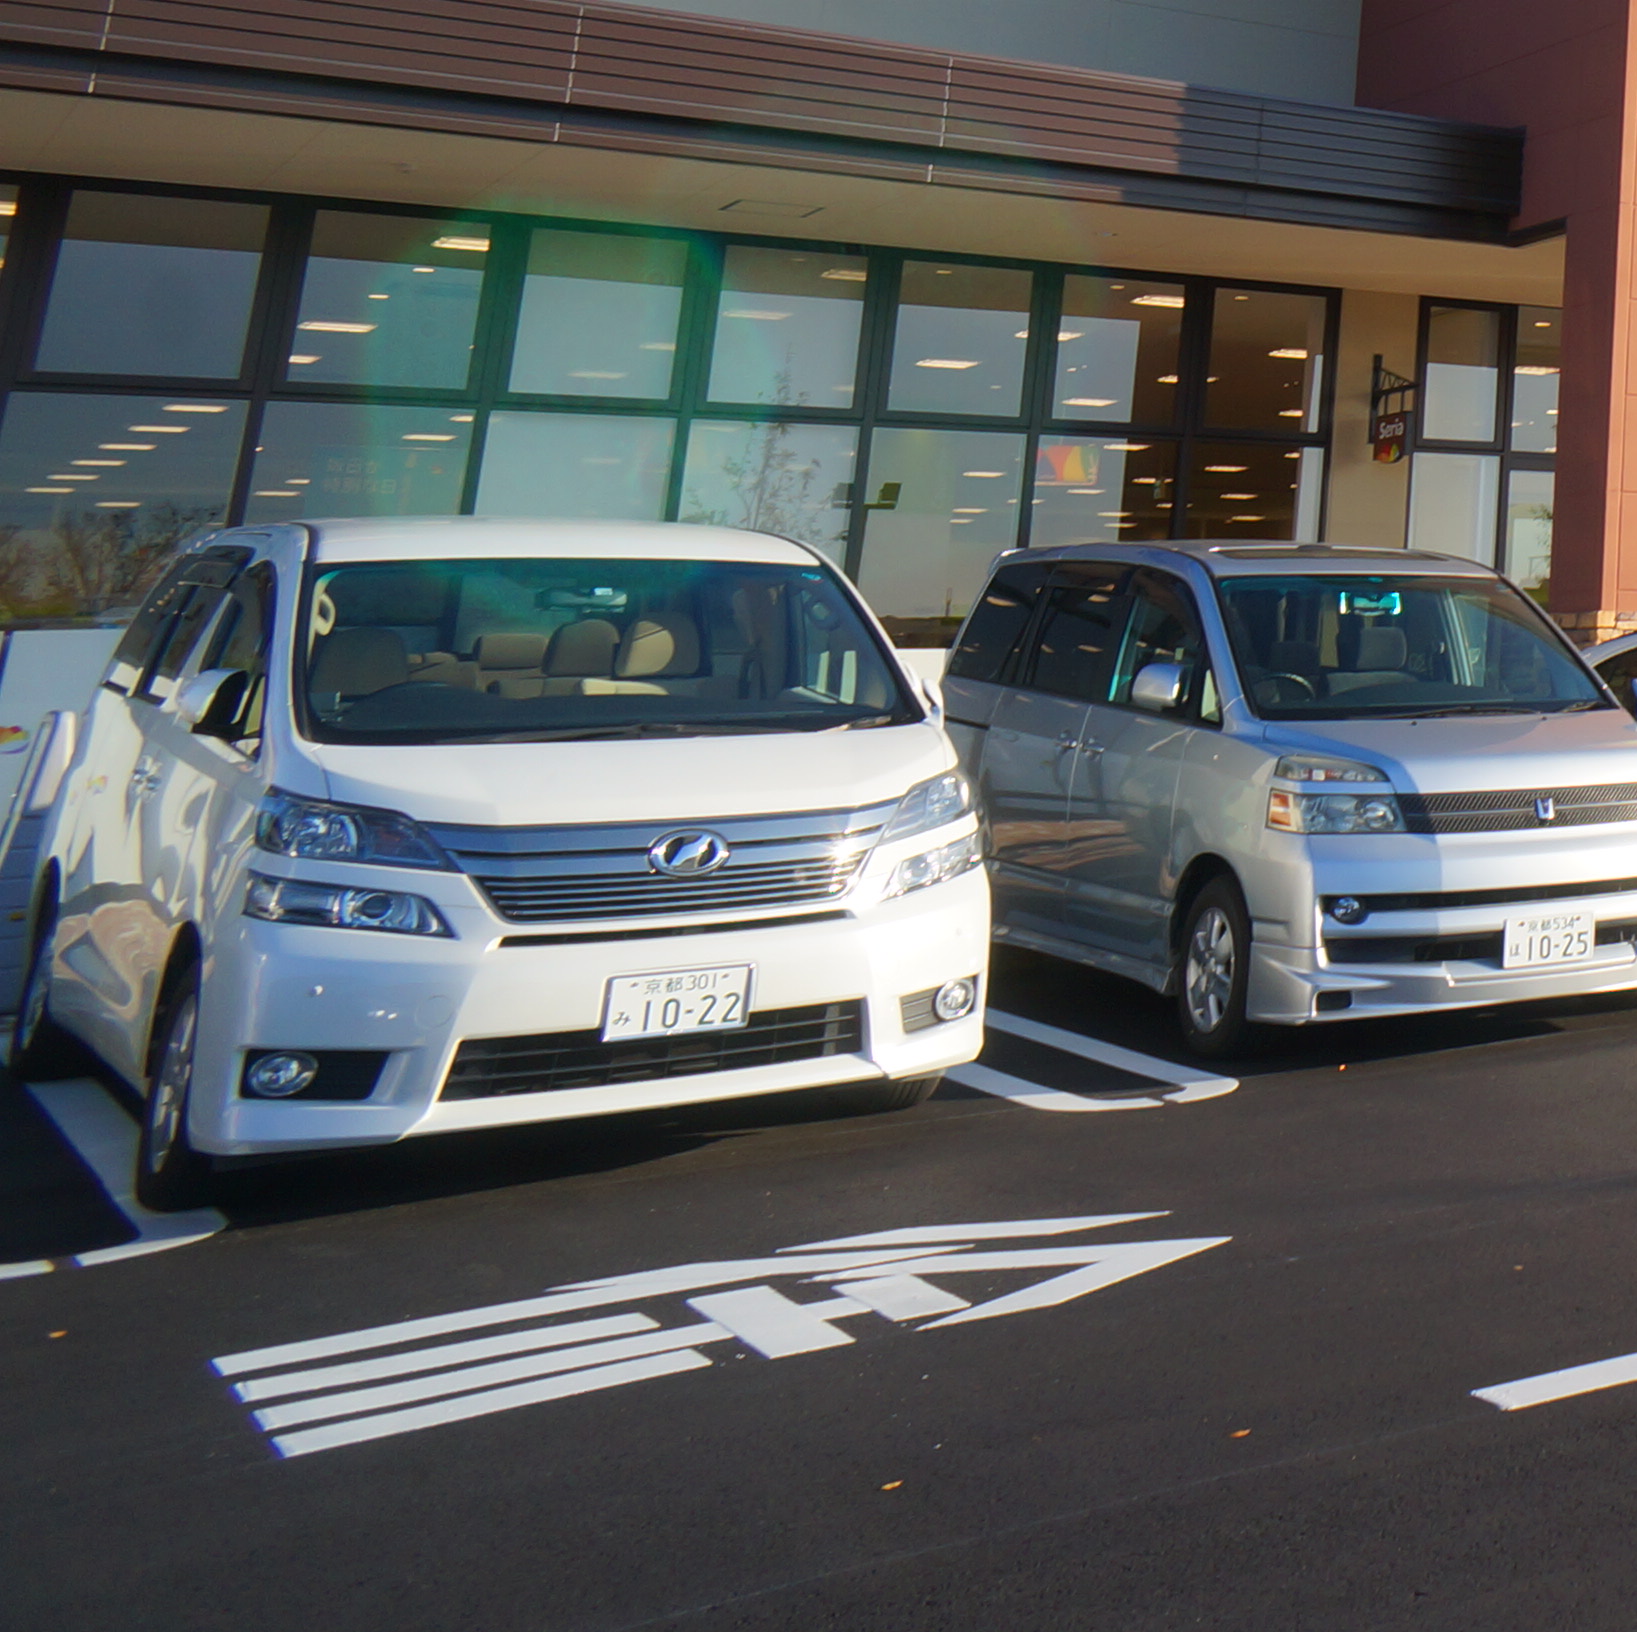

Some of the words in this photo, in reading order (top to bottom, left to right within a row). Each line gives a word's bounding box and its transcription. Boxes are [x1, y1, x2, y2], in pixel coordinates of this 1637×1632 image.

[1379, 418, 1404, 439] Seria
[1528, 931, 1589, 961] 10-25
[642, 992, 741, 1032] 10-22
